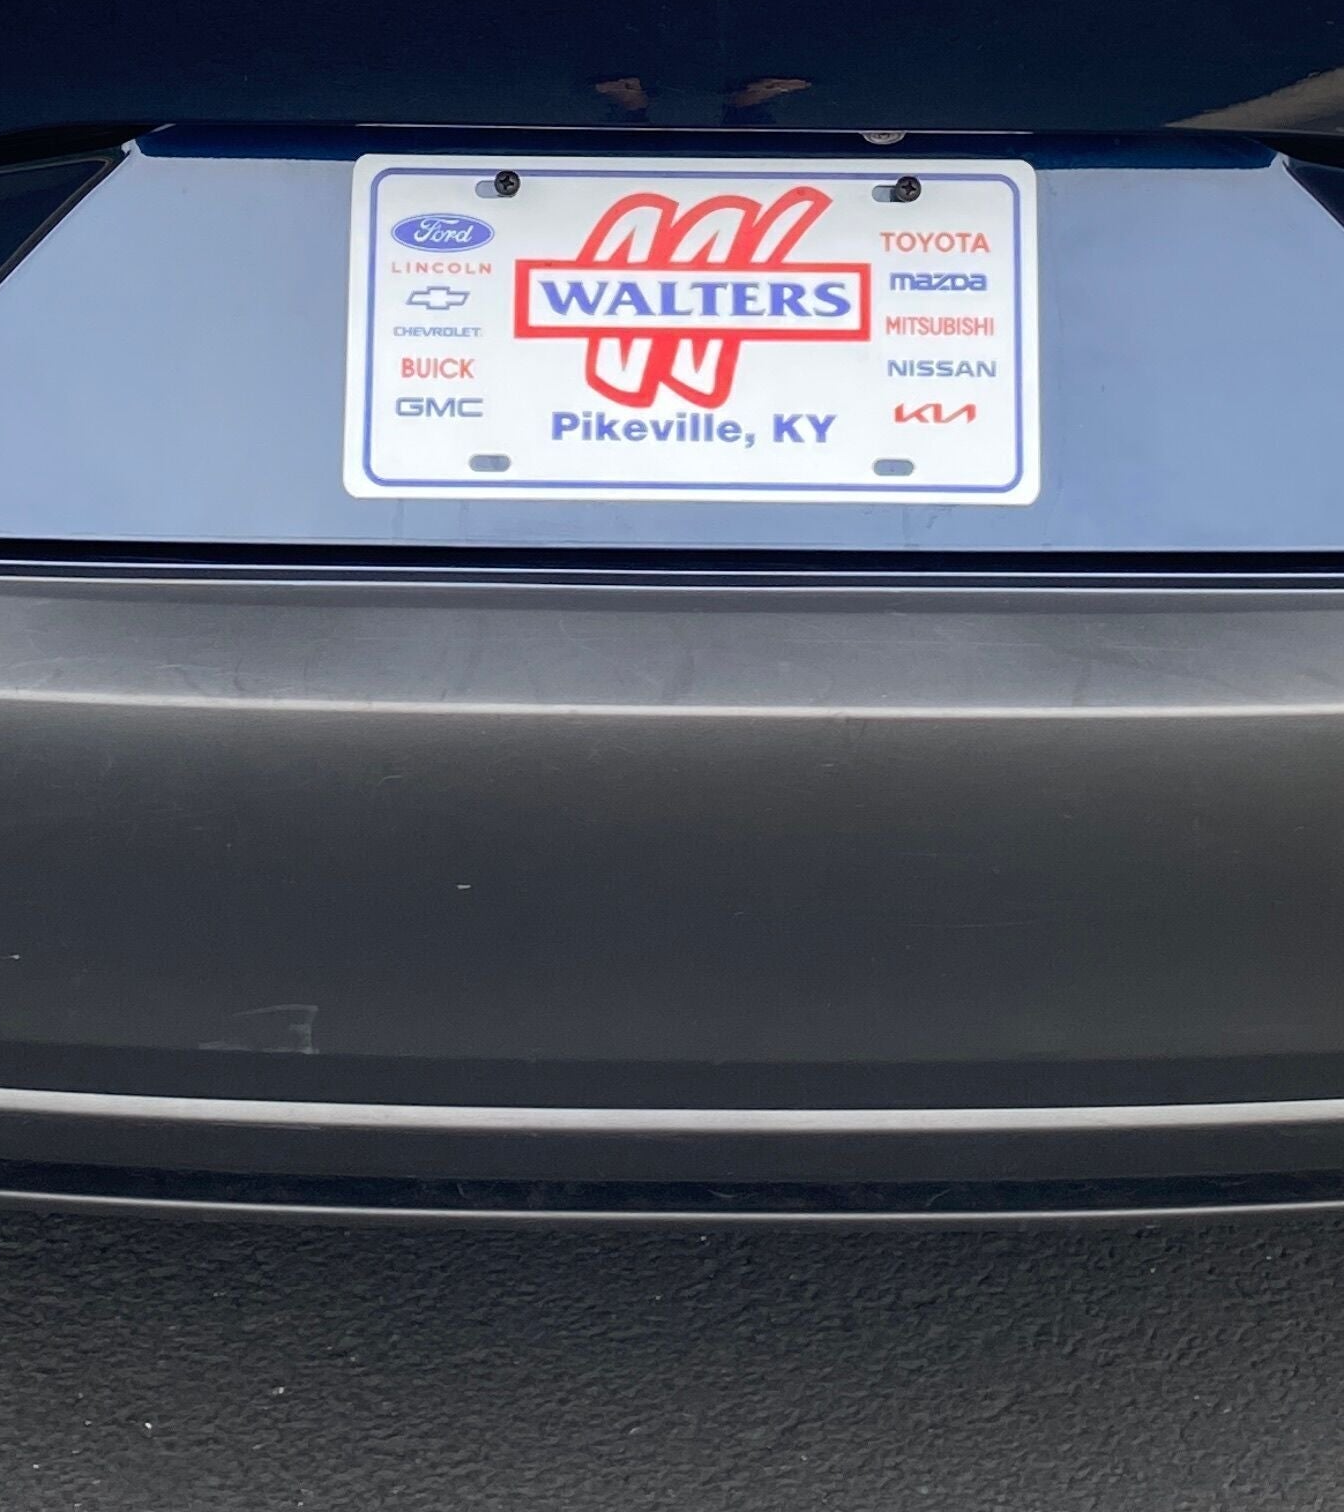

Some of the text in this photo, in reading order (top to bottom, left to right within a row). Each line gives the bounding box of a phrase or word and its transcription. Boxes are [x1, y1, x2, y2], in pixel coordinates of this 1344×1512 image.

[413, 217, 474, 243] Ford
[880, 231, 991, 253] TOYOTA
[391, 261, 492, 275] LINCOLN
[541, 280, 851, 319] WALTERS
[393, 326, 482, 337] CHEVROLET
[885, 316, 995, 336] MITSUBISHI
[401, 357, 475, 379] BUICK
[887, 359, 997, 378] NISSAN
[395, 396, 484, 418] GMC
[552, 411, 837, 449] Pikeville, KY
